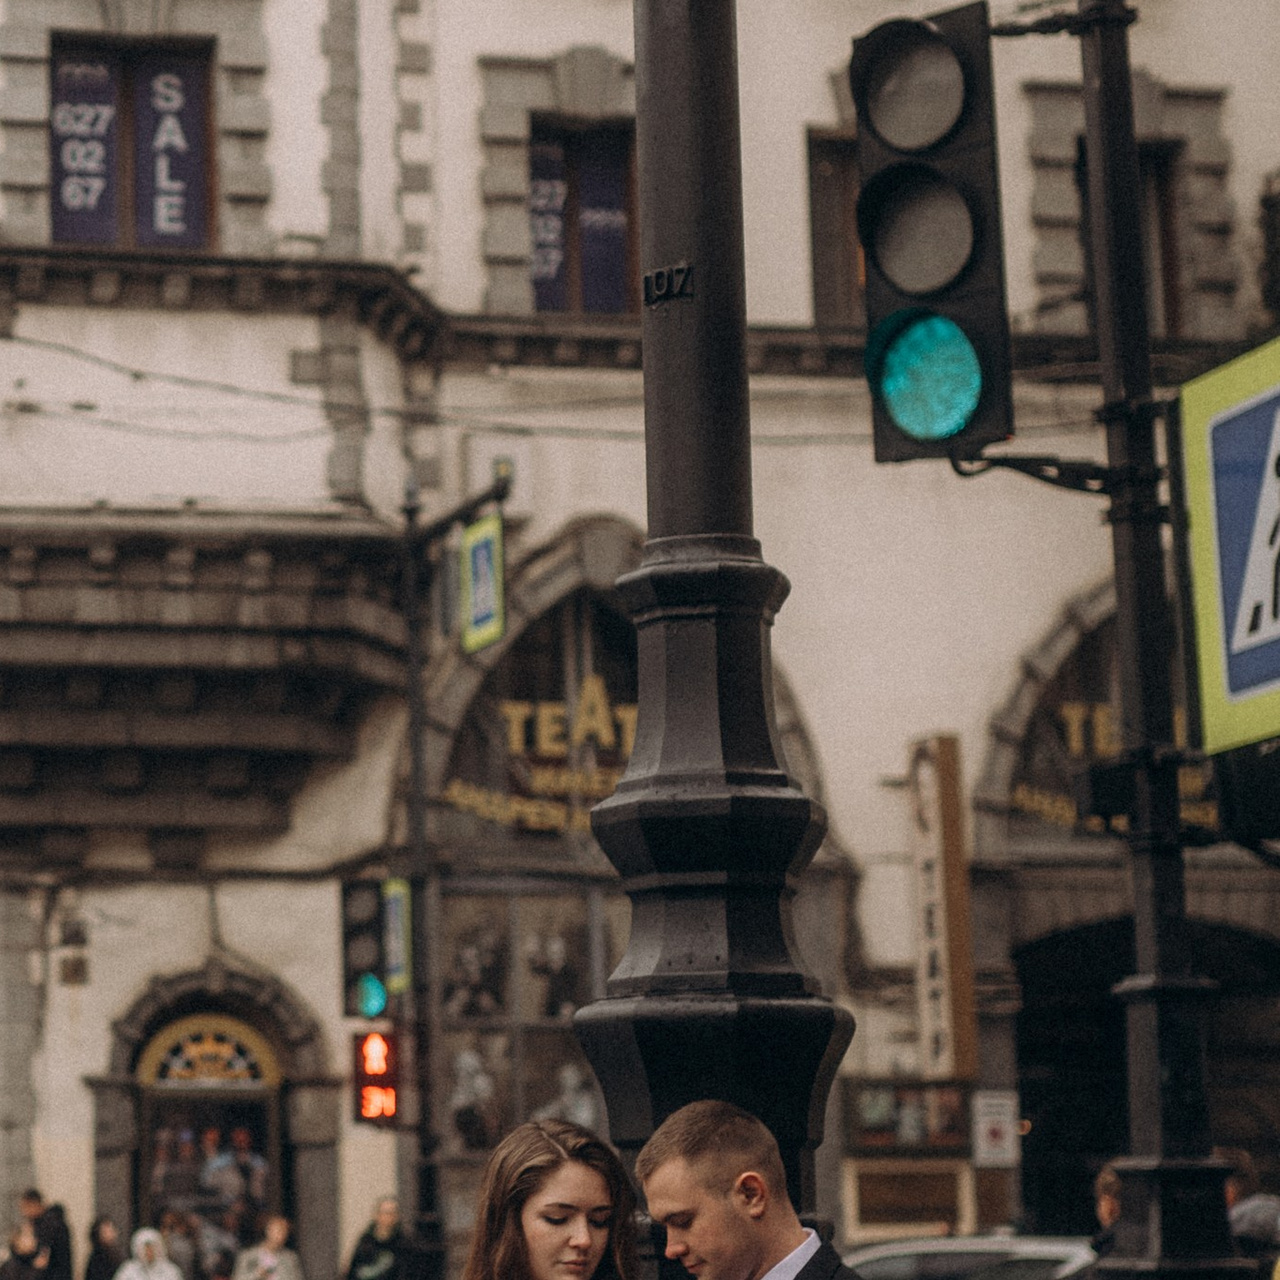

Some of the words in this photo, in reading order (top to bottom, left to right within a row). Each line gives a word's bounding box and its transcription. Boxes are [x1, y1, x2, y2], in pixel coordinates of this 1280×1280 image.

[52, 102, 117, 136] 627
[150, 74, 188, 235] SALE
[498, 674, 638, 757] ТЕАТ
